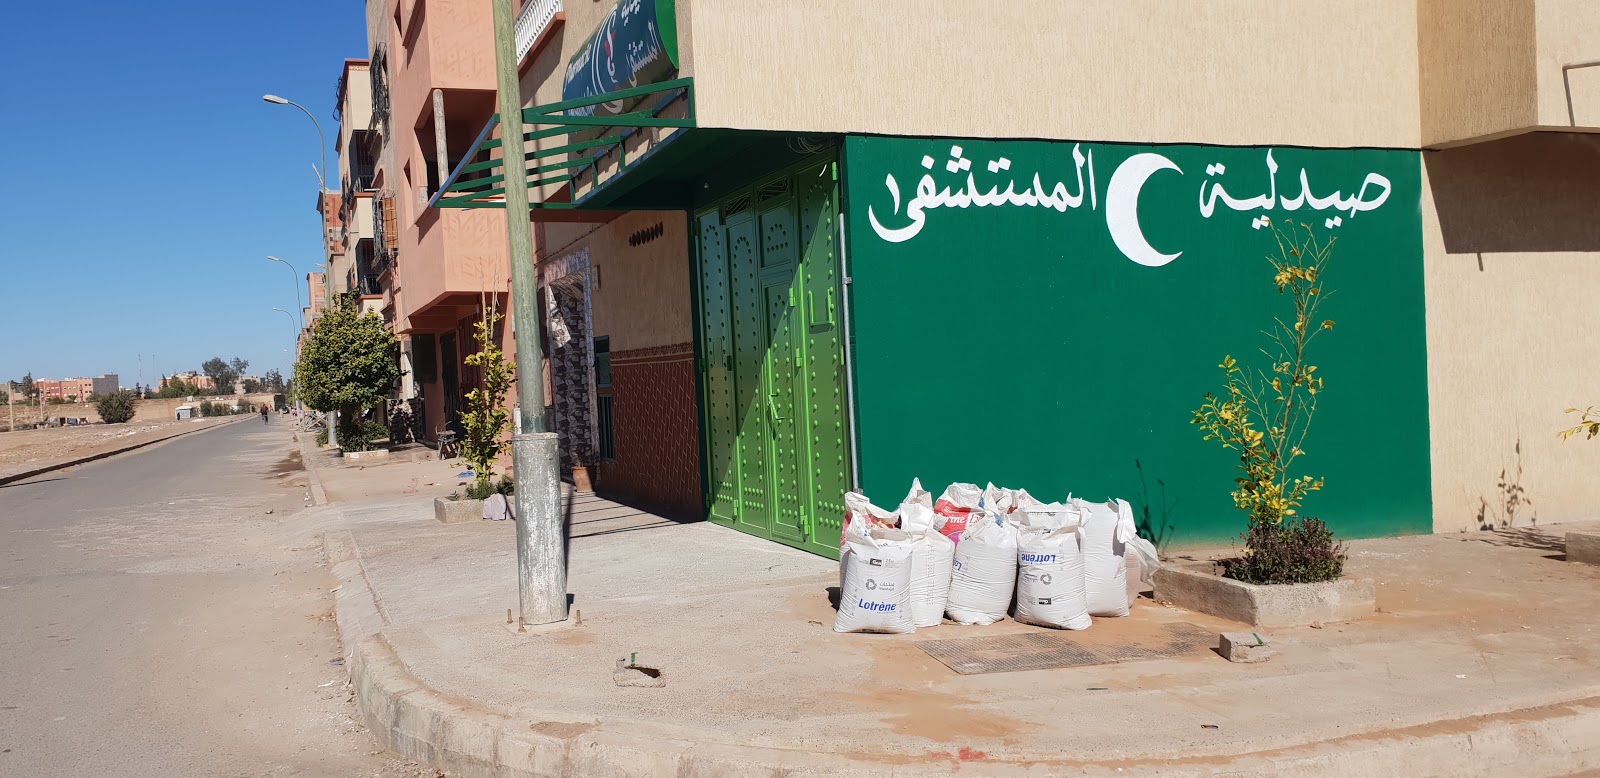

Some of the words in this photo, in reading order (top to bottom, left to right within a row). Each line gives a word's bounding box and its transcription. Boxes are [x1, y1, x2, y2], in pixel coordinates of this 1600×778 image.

[868, 142, 1097, 243] المستشفى
[1199, 148, 1392, 230] صيدلية
[858, 598, 897, 612] Lotrène
